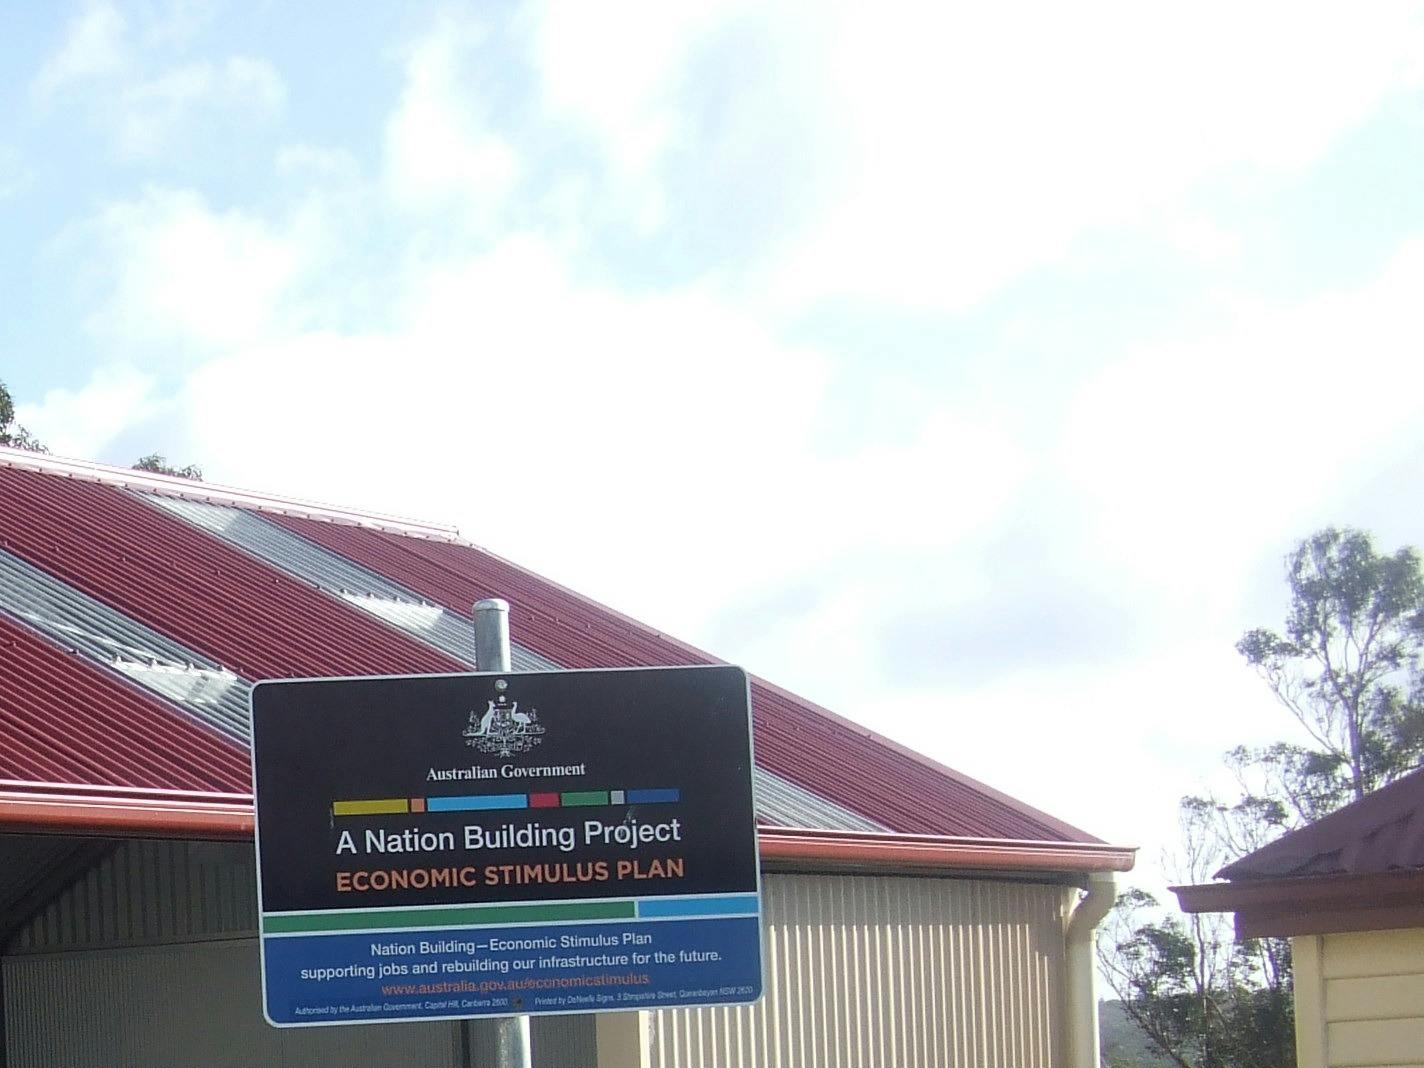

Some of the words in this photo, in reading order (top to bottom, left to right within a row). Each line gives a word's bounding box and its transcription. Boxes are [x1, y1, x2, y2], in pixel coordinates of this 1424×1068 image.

[426, 765, 497, 782] Australian
[501, 763, 586, 779] Government
[335, 831, 357, 855] A
[365, 827, 454, 853] Nation
[464, 822, 575, 853] Building
[584, 819, 681, 849] Project
[336, 866, 476, 892] ECONOMIC
[485, 861, 609, 886] STIMULUS
[617, 857, 685, 881] PLAN
[370, 942, 415, 956] Nation
[560, 934, 619, 948] Stimulus
[623, 933, 652, 945] Plan
[300, 963, 375, 981] supporting
[378, 962, 408, 979] jobs
[412, 961, 438, 974] and
[442, 957, 509, 974] rebuilding
[512, 959, 534, 970] our
[539, 953, 628, 968] infrastructure
[632, 952, 650, 965] for
[654, 951, 676, 964] the
[679, 949, 722, 963] future.
